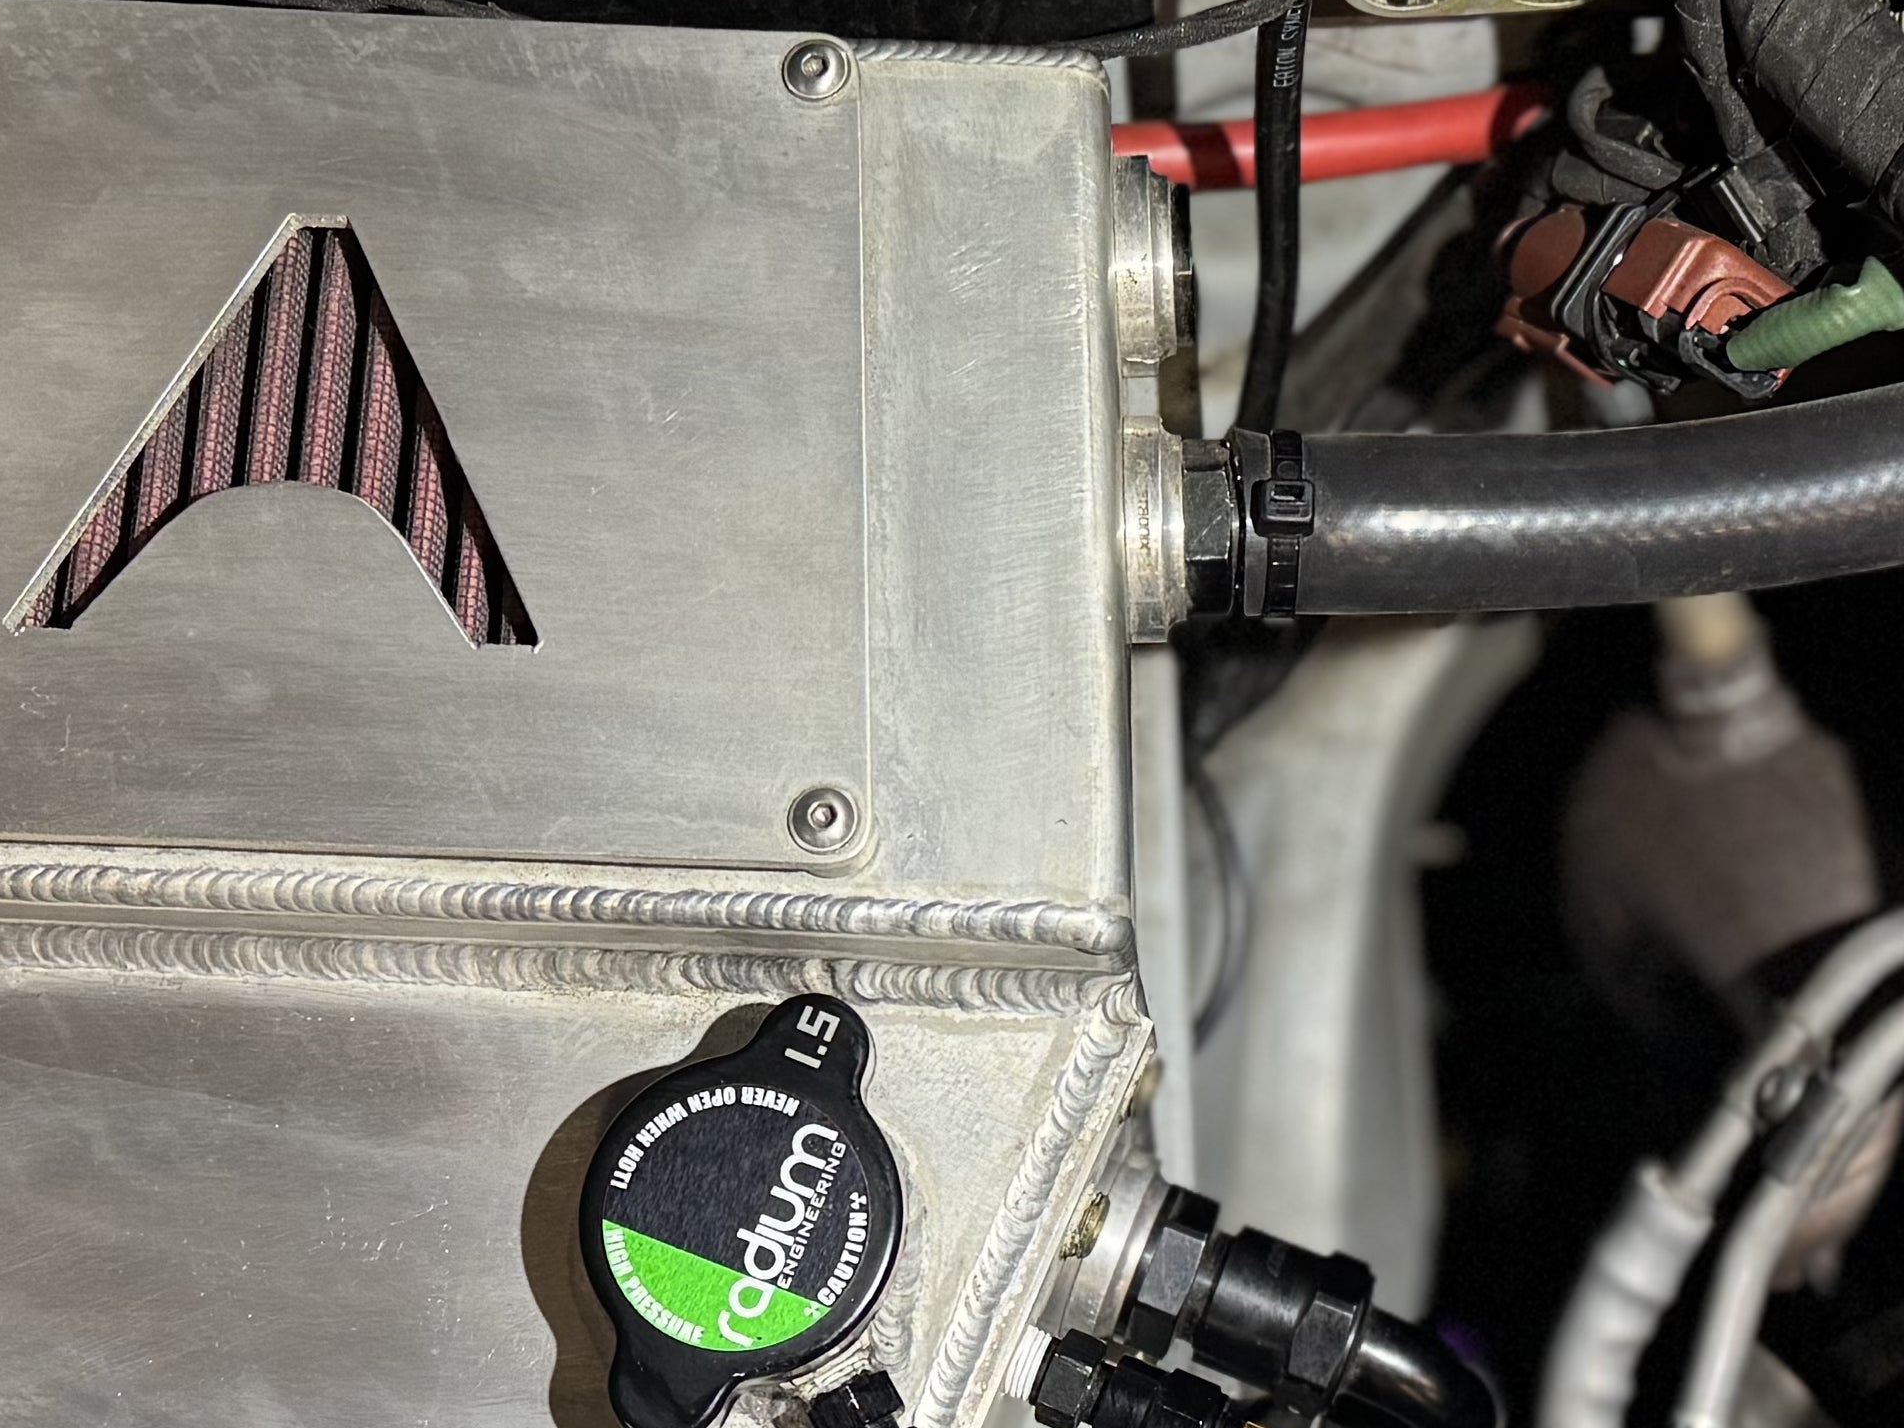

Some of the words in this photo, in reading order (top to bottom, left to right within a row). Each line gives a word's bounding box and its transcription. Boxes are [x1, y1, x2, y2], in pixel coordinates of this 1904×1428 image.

[784, 1005, 841, 1069] 1.5
[634, 1101, 689, 1147] WHEN
[687, 1087, 736, 1115] OPEN
[741, 1086, 801, 1117] NEVER
[717, 1123, 840, 1348] radium
[777, 1140, 848, 1291] ENGINEERING
[604, 1228, 632, 1277] HIGH
[623, 1274, 706, 1344] PRESSURE
[816, 1211, 869, 1307] CAUTION
